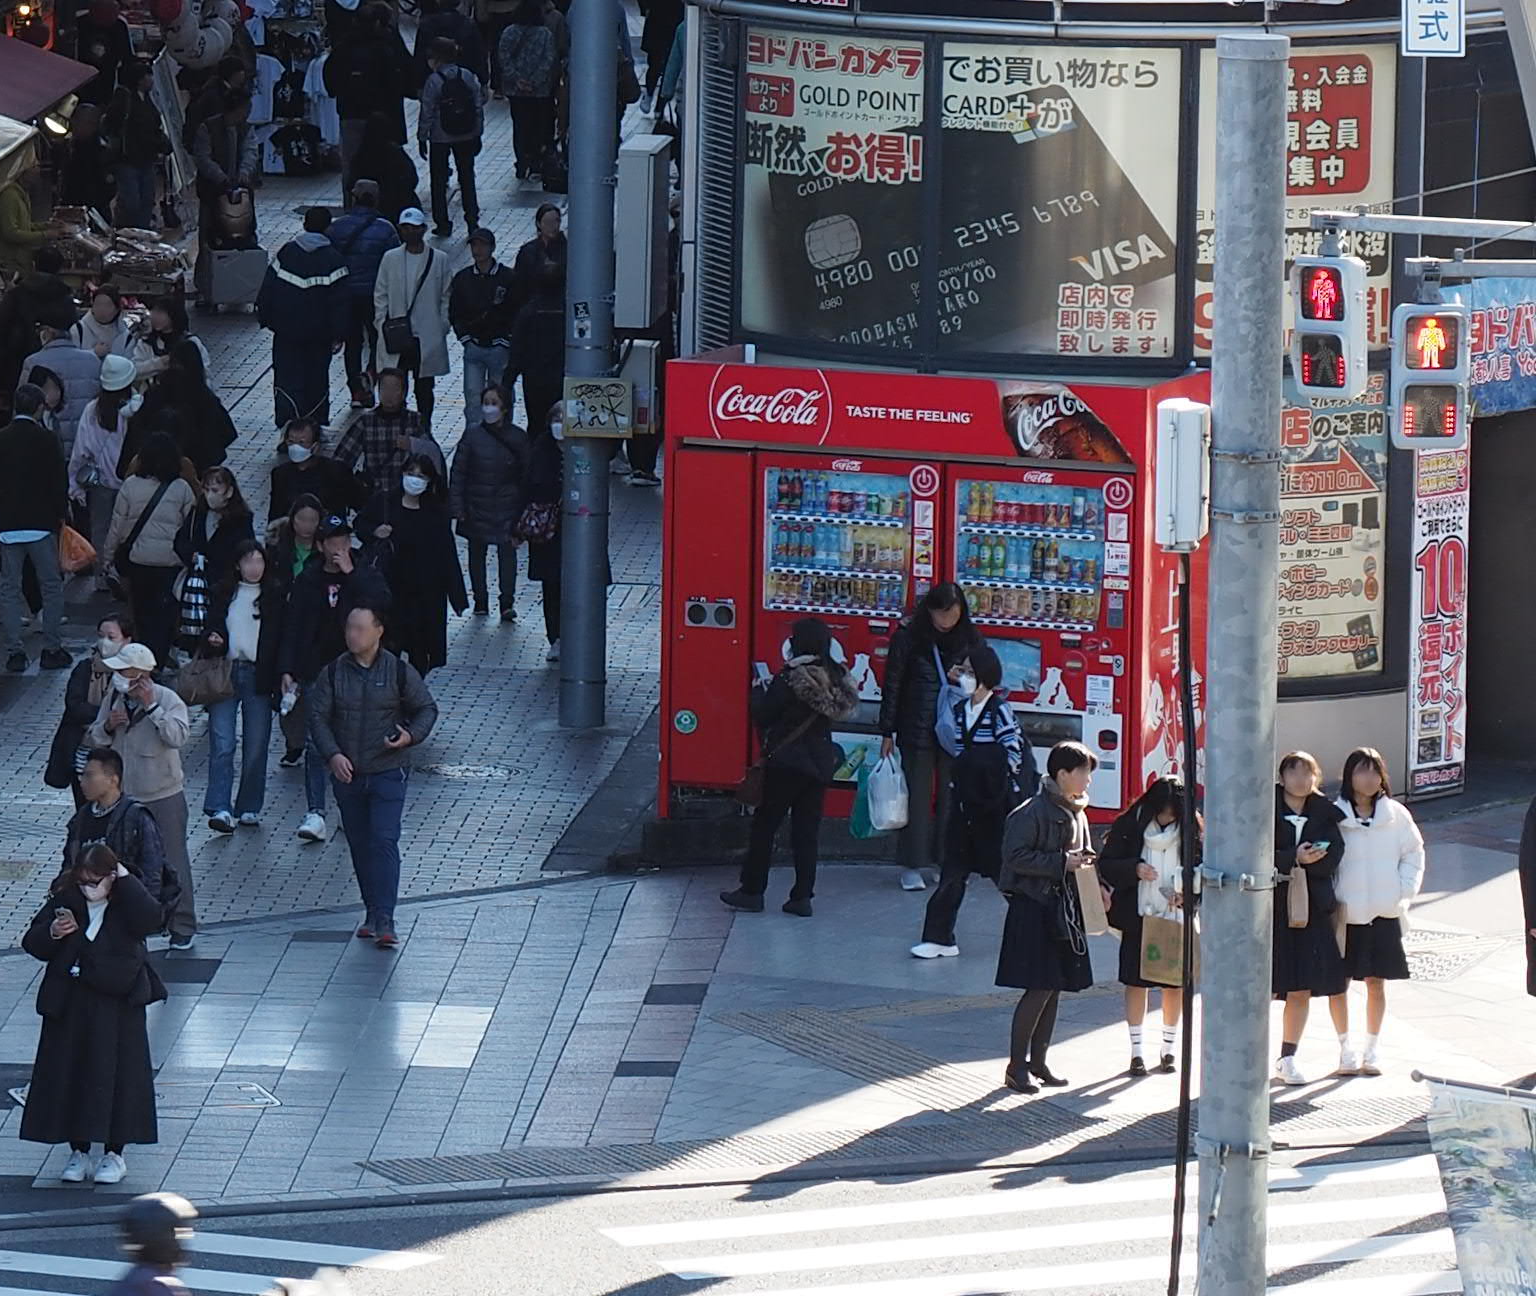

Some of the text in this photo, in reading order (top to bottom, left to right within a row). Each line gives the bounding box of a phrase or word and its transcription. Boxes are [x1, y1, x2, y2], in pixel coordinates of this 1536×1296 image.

[746, 33, 925, 79] ヨドバシカメラ
[943, 55, 1160, 89] でお買い物なら
[748, 77, 791, 98] 他カード
[758, 95, 778, 112] より
[799, 85, 851, 108] GOLD
[856, 88, 922, 115] POINT
[944, 93, 1006, 117] CARD
[814, 259, 874, 295] 4980
[953, 211, 1022, 250] 2345
[1032, 190, 1101, 224] 6789
[1078, 233, 1167, 283] VISA
[1059, 285, 1134, 307] 店内で
[1059, 309, 1158, 331] 即時発行
[1059, 335, 1169, 355] 致します!
[716, 383, 823, 427] Coca-Cola
[845, 405, 887, 421] TASTE
[888, 407, 914, 422] THE
[915, 408, 972, 425] FEELING
[1415, 535, 1467, 621] 10
